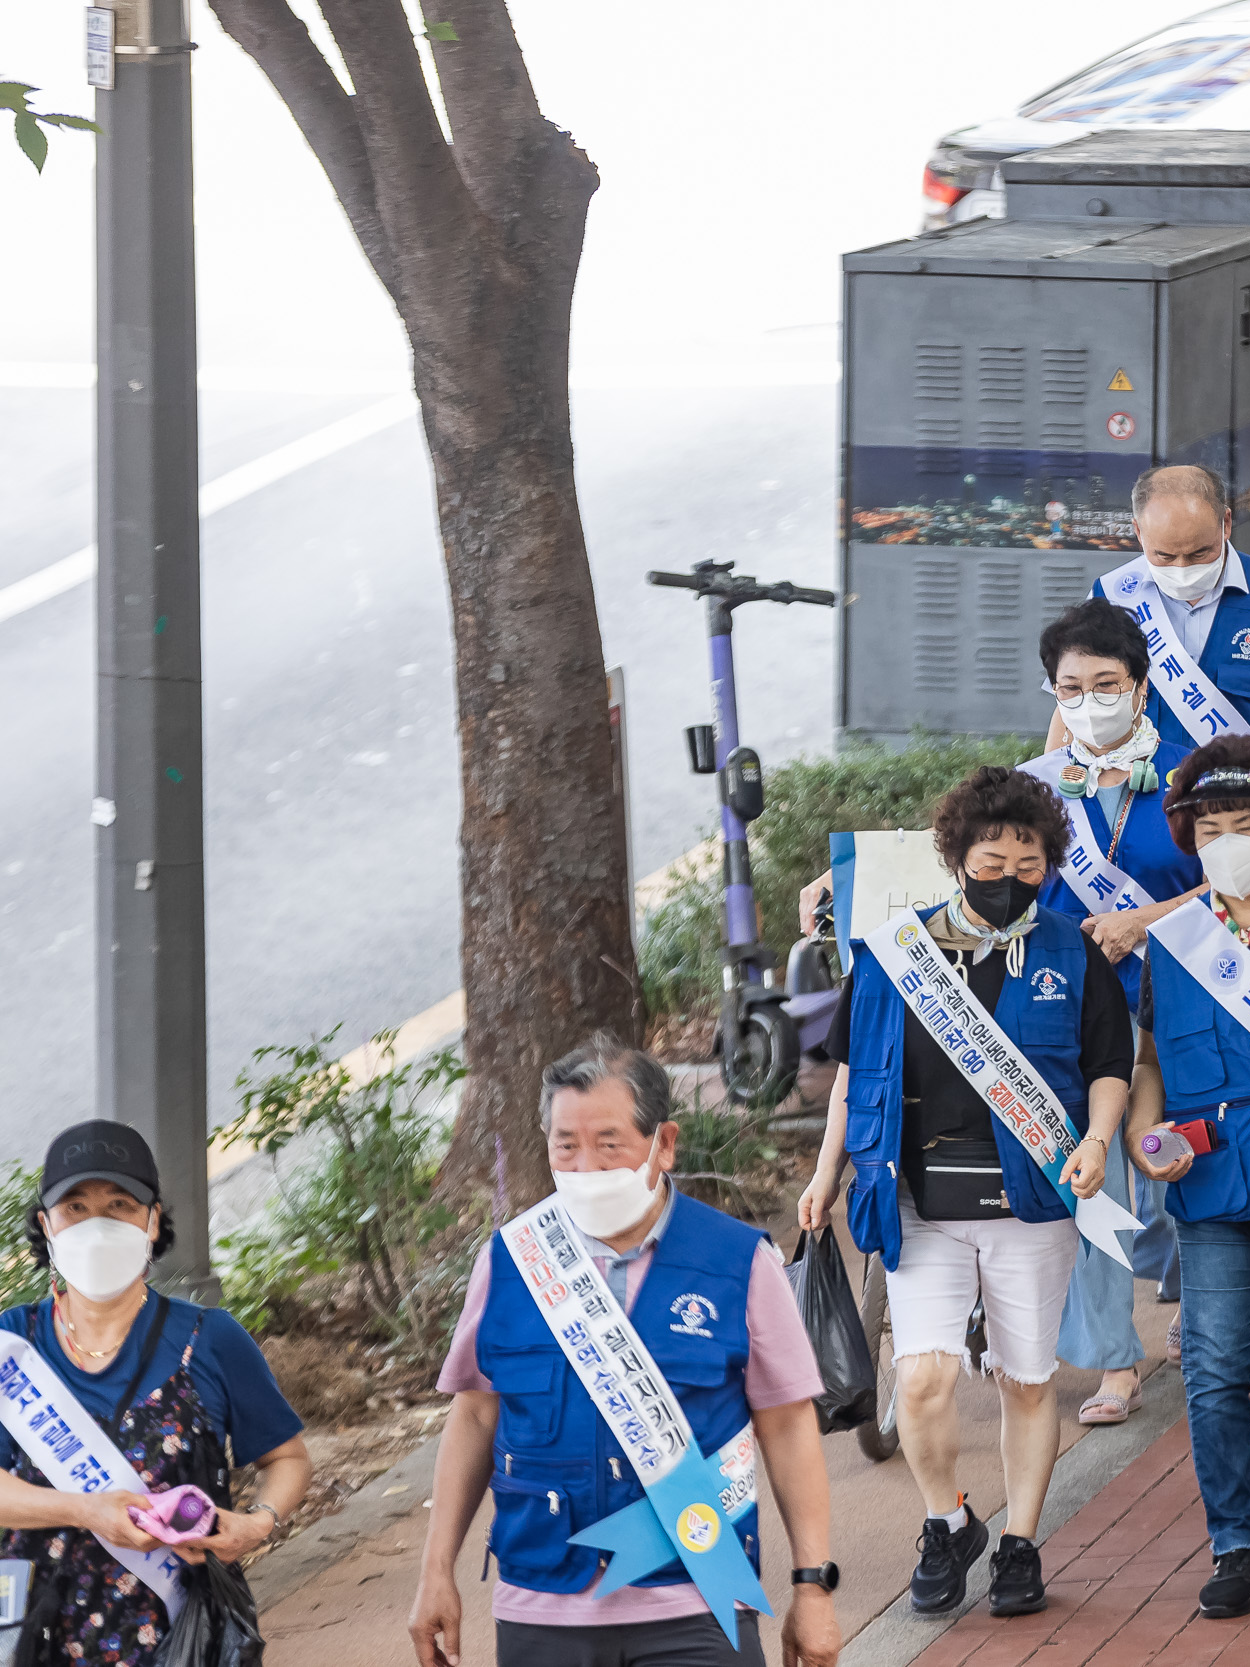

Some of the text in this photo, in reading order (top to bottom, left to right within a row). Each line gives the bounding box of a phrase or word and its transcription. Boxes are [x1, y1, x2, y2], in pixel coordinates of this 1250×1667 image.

[1134, 601, 1229, 736] 바르게살기
[63, 1141, 130, 1165] ping
[900, 969, 1055, 1163] 마스크착용 철저히!
[512, 1223, 661, 1470] 코로나19 방역수칙준수
[537, 1207, 686, 1454] 여름철 행락 질서지키기
